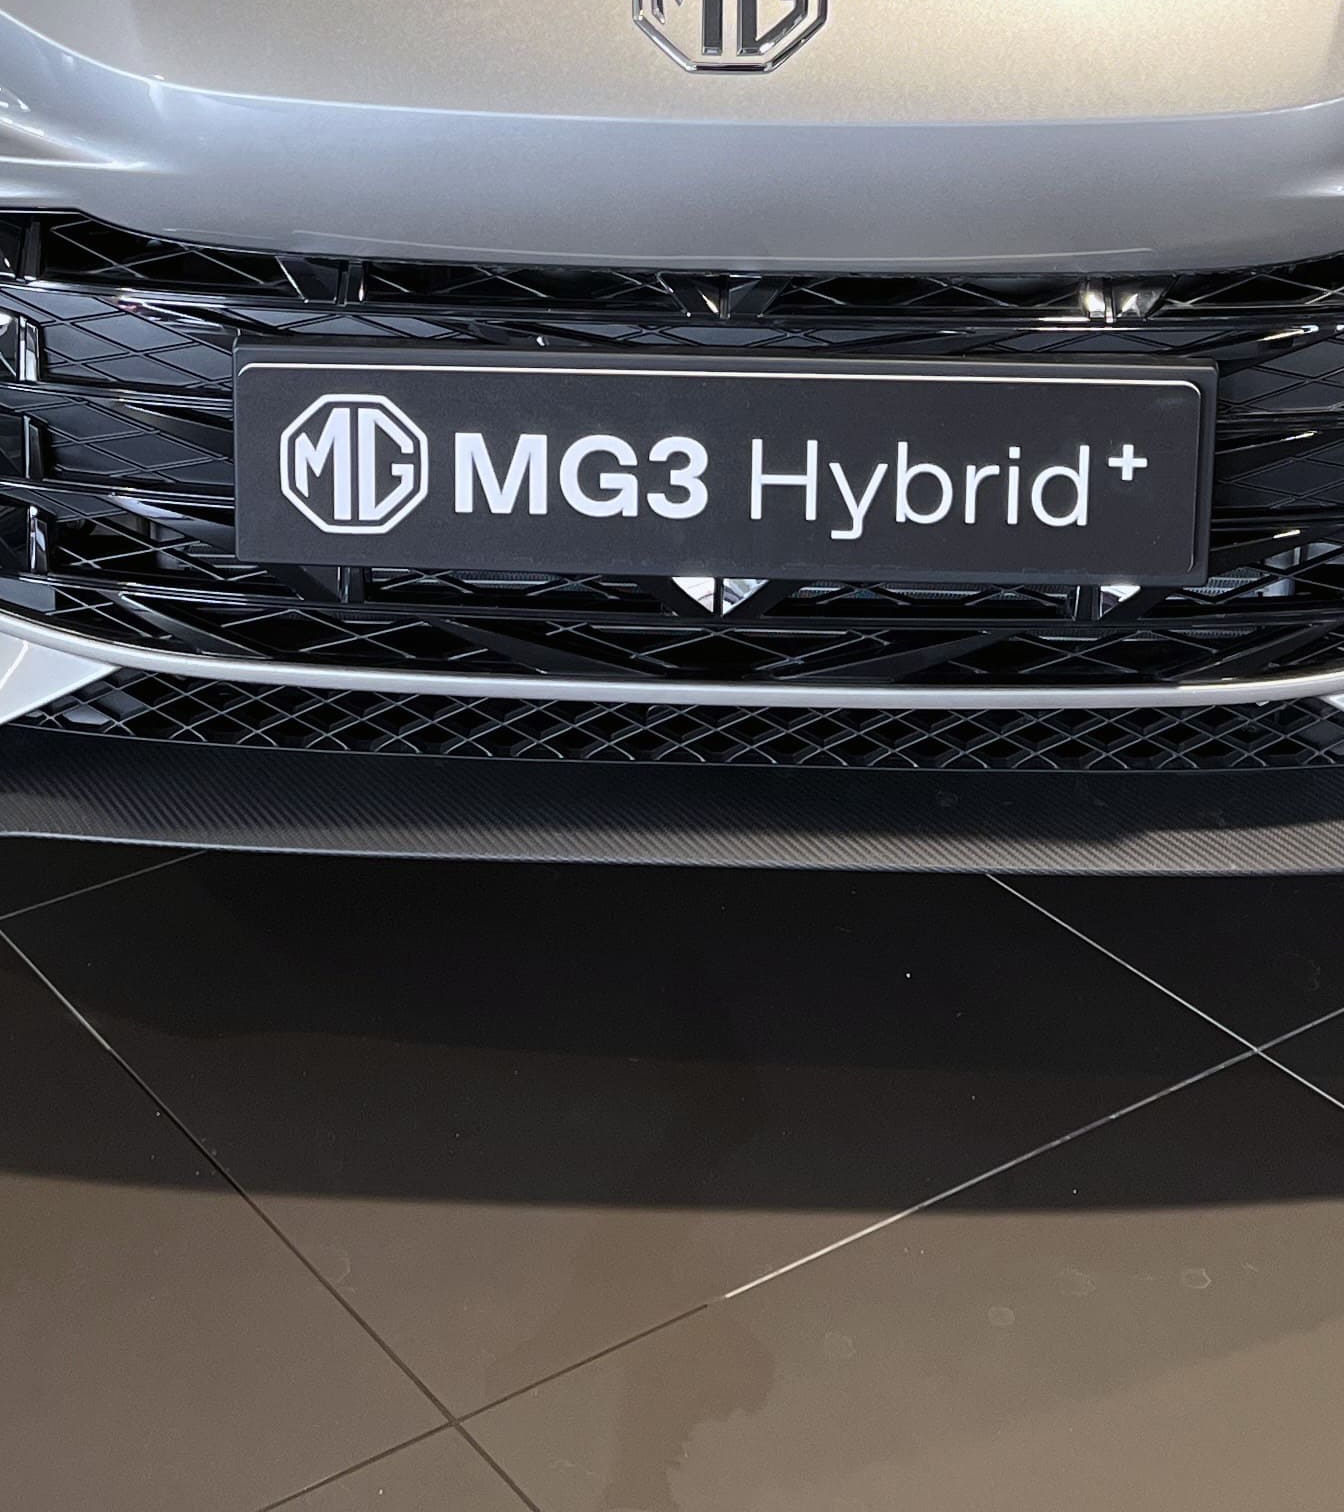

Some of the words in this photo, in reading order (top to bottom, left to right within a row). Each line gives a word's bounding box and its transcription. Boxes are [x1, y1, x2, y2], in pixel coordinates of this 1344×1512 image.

[294, 407, 415, 521] MG
[455, 432, 709, 520] MG3
[750, 438, 1148, 539] Hybrid+
